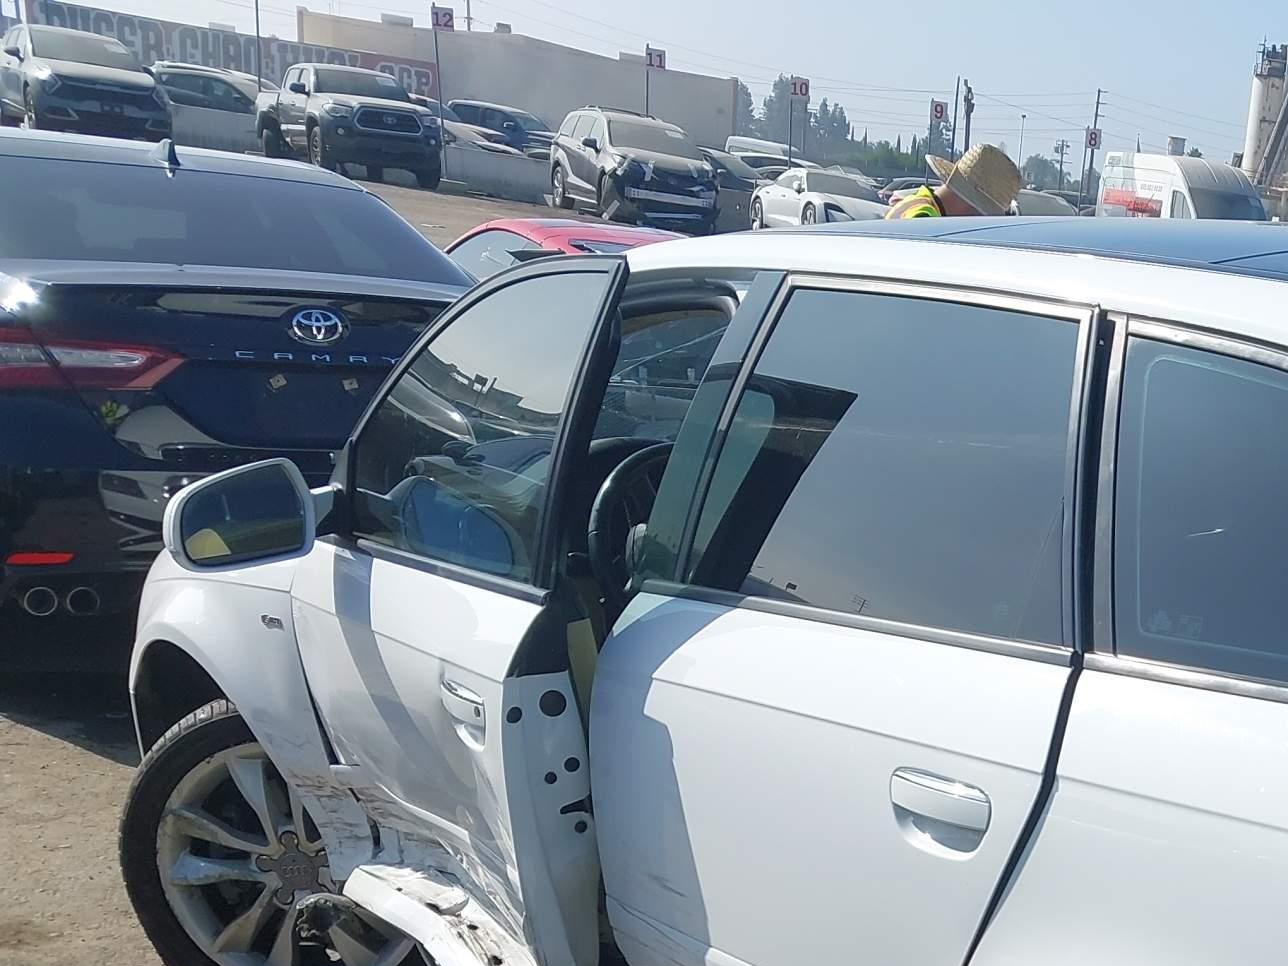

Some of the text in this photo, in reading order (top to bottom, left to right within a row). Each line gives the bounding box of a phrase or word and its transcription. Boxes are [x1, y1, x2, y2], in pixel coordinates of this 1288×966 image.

[433, 11, 453, 28] 12
[647, 52, 665, 69] 11
[791, 81, 809, 96] 10
[934, 103, 944, 119] 9
[1088, 131, 1098, 147] 8
